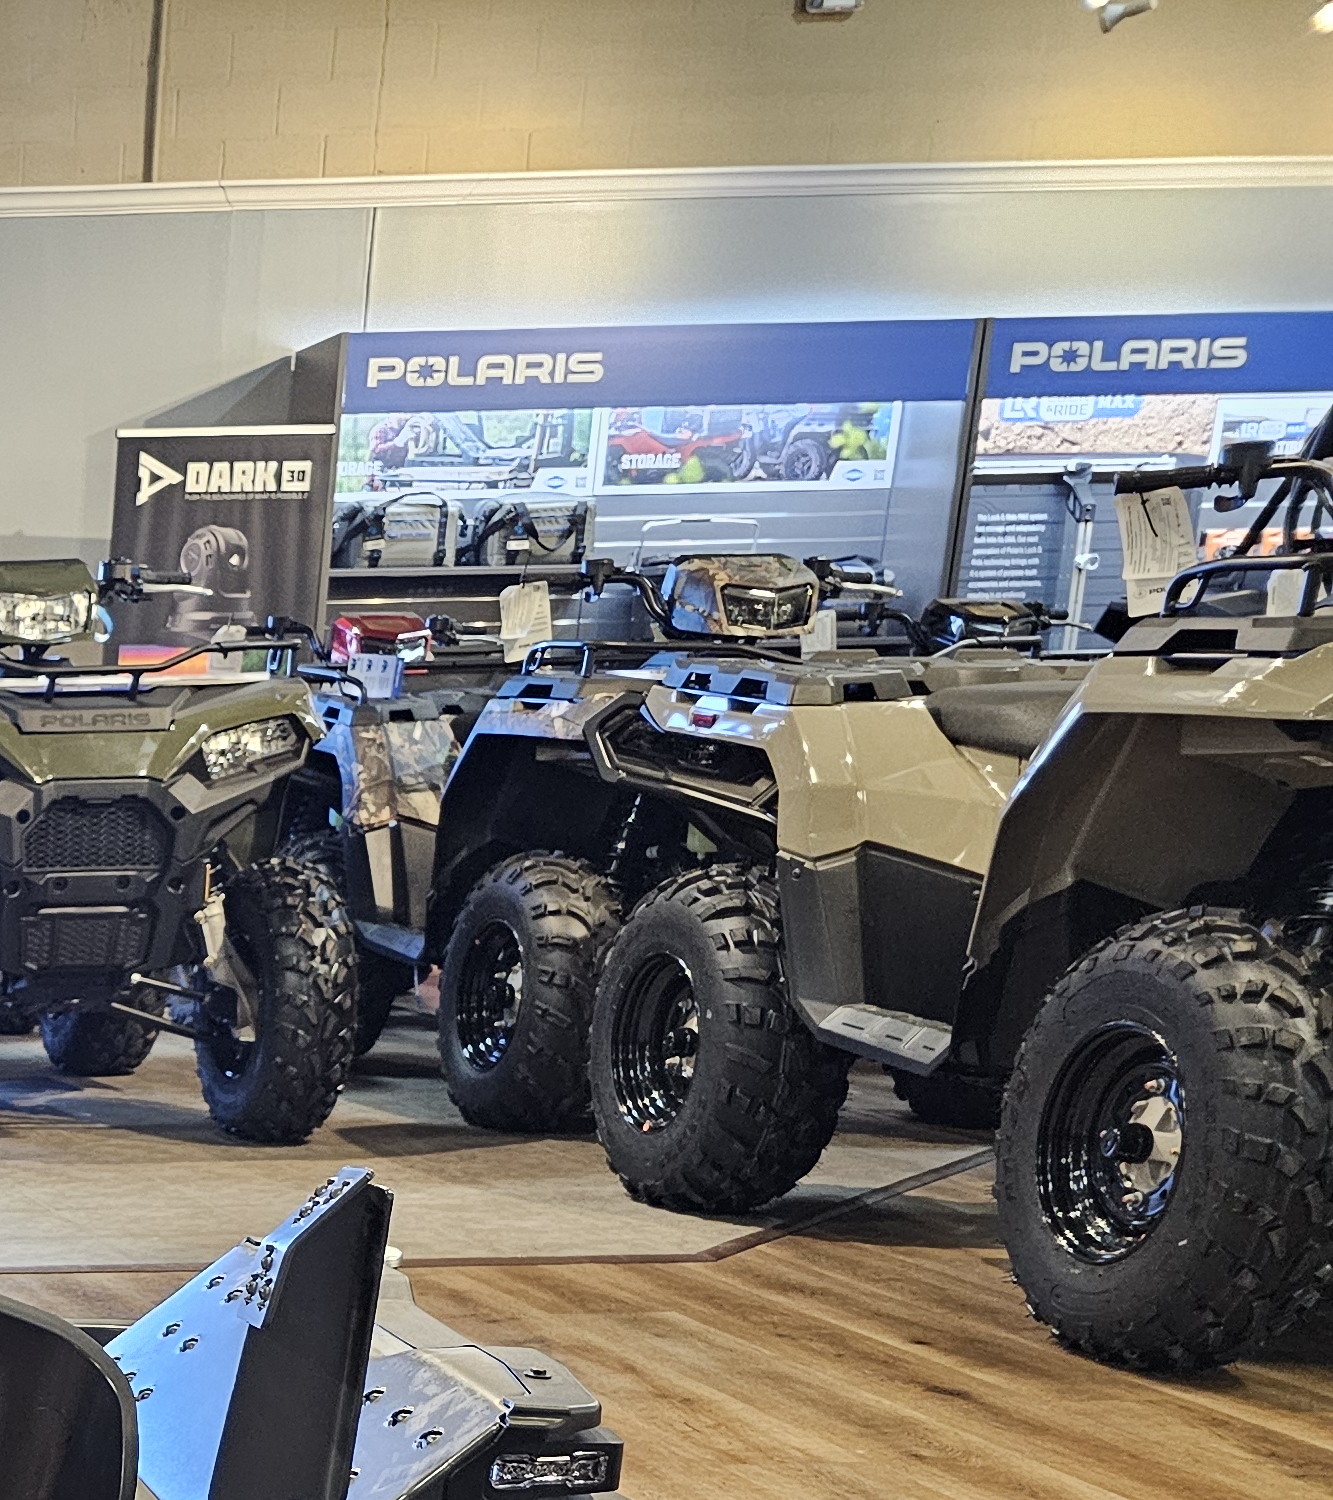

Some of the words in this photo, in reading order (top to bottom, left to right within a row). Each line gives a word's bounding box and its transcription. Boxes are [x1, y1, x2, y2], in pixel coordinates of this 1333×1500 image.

[1009, 337, 1248, 374] POLARIS
[366, 351, 605, 389] POLARIS
[337, 460, 382, 476] ORAGE
[621, 454, 682, 470] STORAGE
[185, 461, 279, 492] DARK
[39, 713, 151, 728] POLARIS
